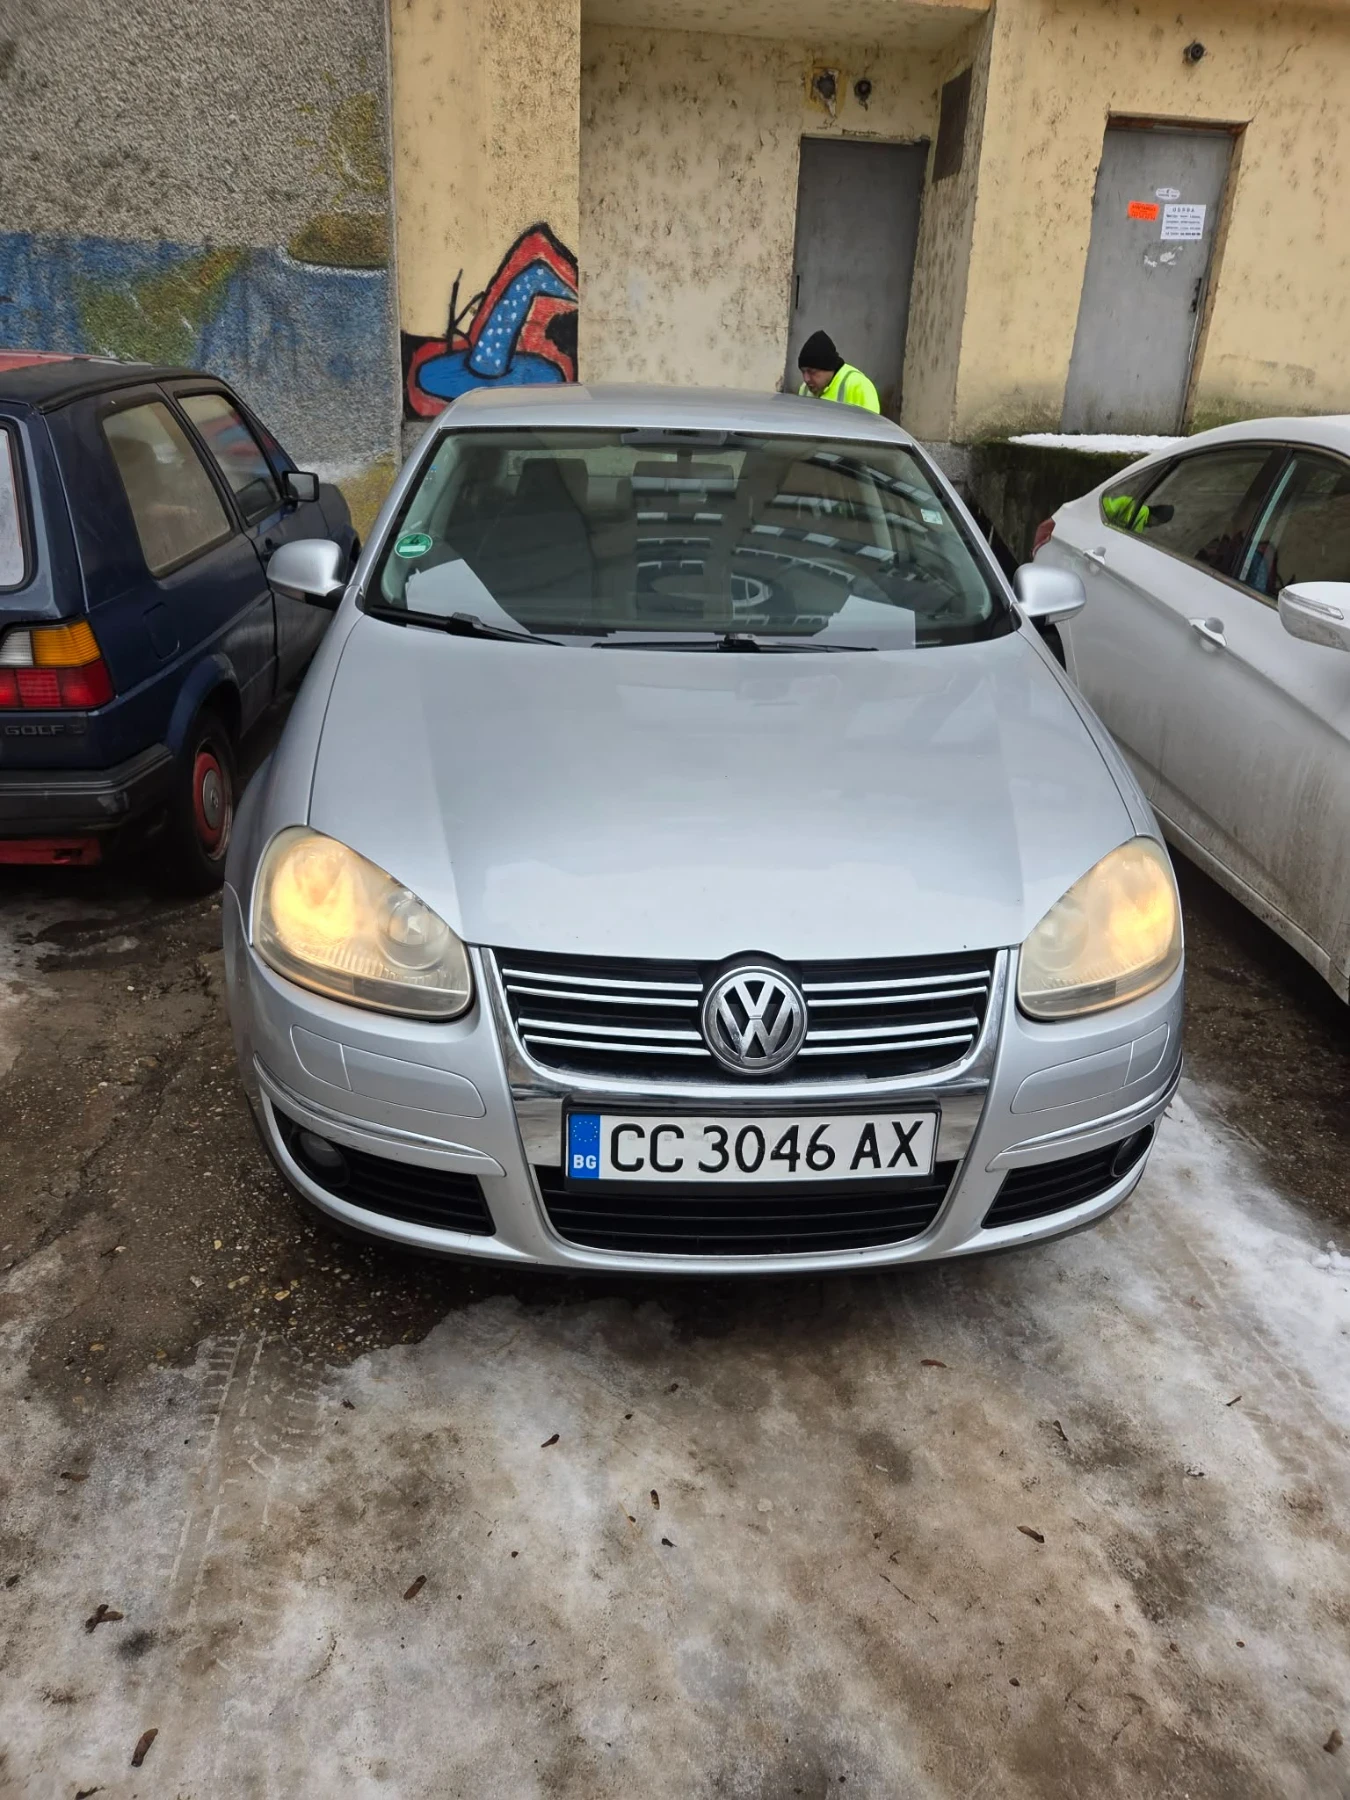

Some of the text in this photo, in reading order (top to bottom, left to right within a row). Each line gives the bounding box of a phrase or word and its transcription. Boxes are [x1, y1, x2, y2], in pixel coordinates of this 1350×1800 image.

[4, 724, 64, 736] GOLF
[712, 974, 797, 1063] VW
[573, 1154, 597, 1170] BG
[610, 1120, 925, 1173] CC 3046 AX
